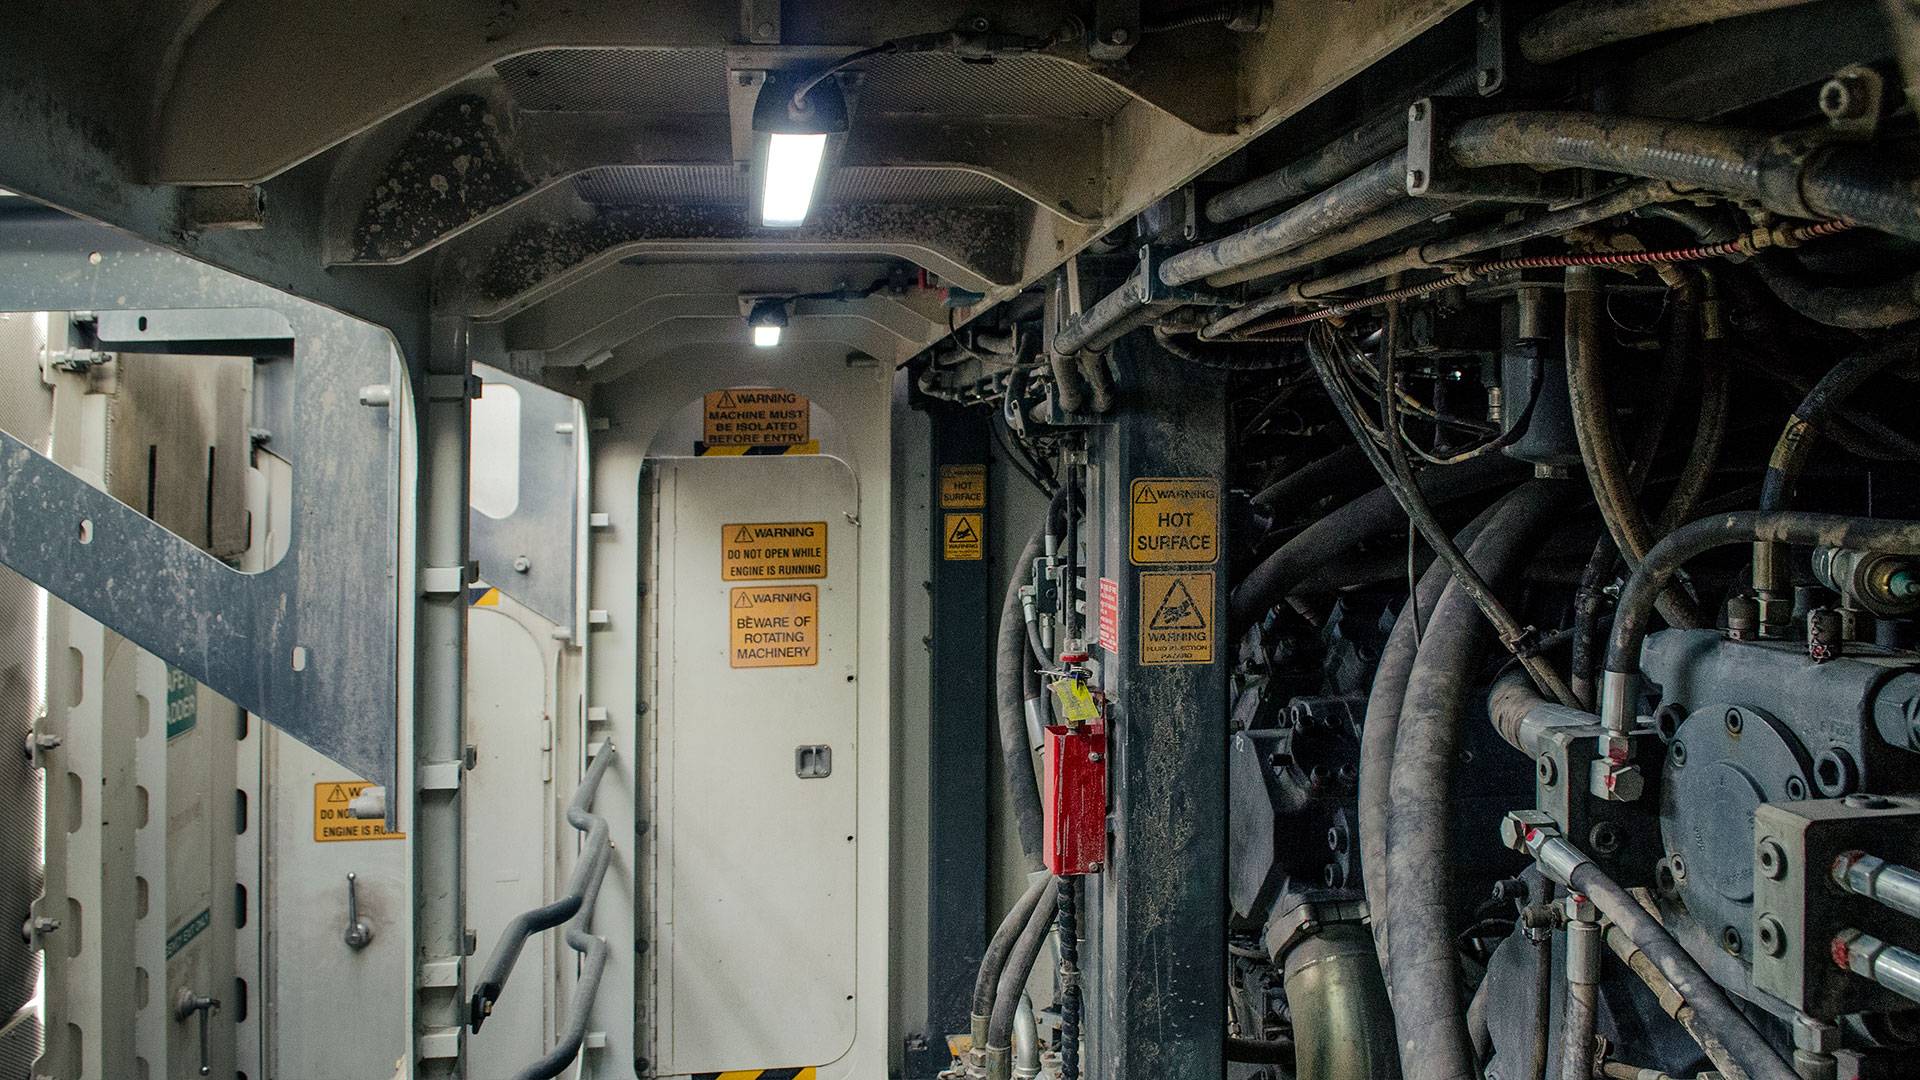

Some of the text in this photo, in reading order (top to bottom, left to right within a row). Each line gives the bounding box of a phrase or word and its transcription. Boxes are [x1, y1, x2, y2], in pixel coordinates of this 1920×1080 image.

[737, 393, 796, 403] WARNING
[709, 410, 803, 420] MACHINE MUST
[716, 422, 797, 431] BE ISOLATED
[709, 434, 760, 443] BEFORE
[944, 493, 981, 501] SURFACE
[1157, 489, 1215, 499] WARNING
[1158, 512, 1193, 527] HOT
[754, 527, 814, 538] WARNING
[1137, 535, 1211, 550] SURFACE
[728, 547, 821, 559] DO NOT OPEN WHILE
[730, 564, 821, 576] ENGINE IS RUNNING
[752, 592, 812, 603] WARNING
[737, 616, 811, 629] BEWARE OF
[744, 632, 804, 643] ROTATING
[737, 646, 811, 659] MACHINERY
[320, 809, 334, 820] DO
[323, 826, 359, 837] ENGINE
[361, 825, 370, 835] IS
